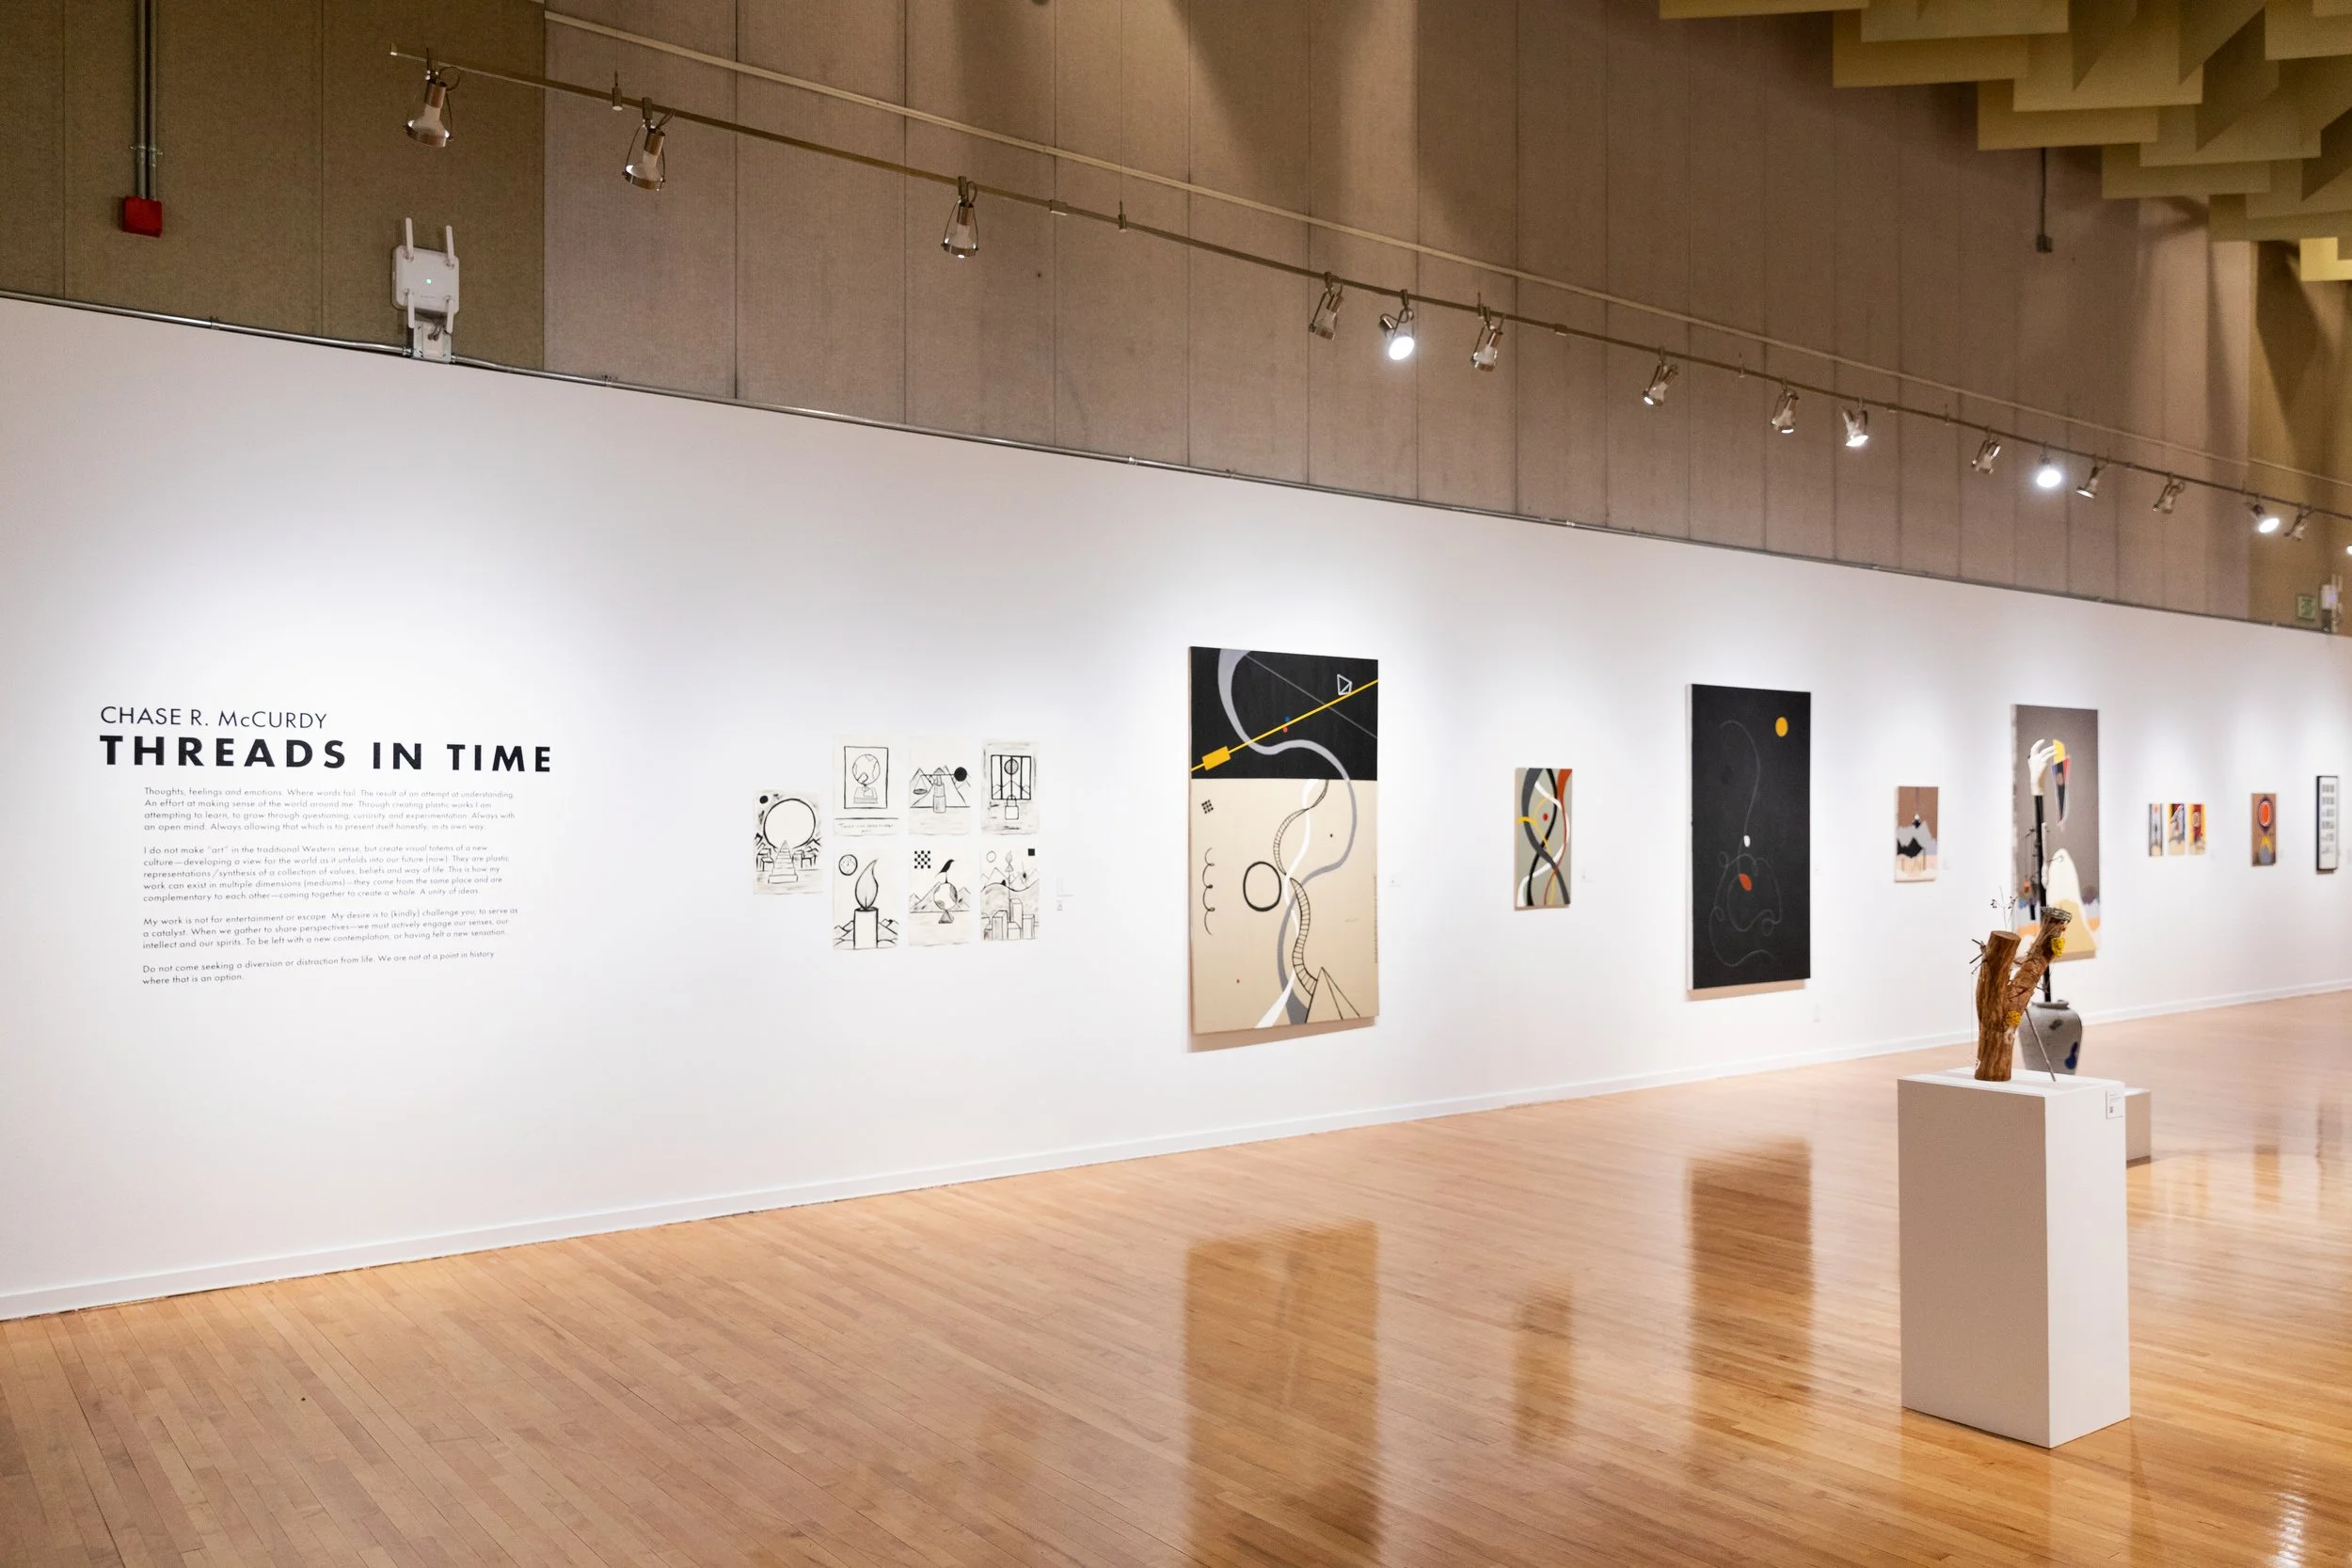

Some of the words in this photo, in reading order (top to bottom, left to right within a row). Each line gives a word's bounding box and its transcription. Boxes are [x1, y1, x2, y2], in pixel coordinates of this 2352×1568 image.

[101, 706, 181, 725] CHASE
[191, 709, 209, 725] R.
[218, 711, 327, 728] McCURDY
[100, 736, 345, 769] THREADS
[373, 742, 422, 770] IN
[447, 744, 550, 771] TIME
[188, 786, 223, 798] feelings
[224, 787, 242, 796] and
[144, 799, 158, 807] An
[159, 799, 184, 807] effort
[198, 800, 230, 809] making
[257, 799, 267, 807] of
[309, 800, 340, 808] around
[143, 811, 192, 821] attempting
[242, 813, 266, 821] grow
[266, 811, 300, 821] through
[157, 824, 182, 832] open
[210, 821, 242, 832] Always
[243, 822, 280, 832] allowing
[149, 846, 162, 854] do
[180, 846, 204, 854] make
[256, 845, 300, 853] traditional
[263, 856, 277, 864] for
[294, 856, 318, 864] world
[257, 868, 267, 877] of
[277, 867, 317, 876] collection
[318, 866, 327, 875] of
[358, 866, 385, 875] beliefs
[404, 868, 421, 877] way
[142, 881, 167, 890] work
[217, 879, 253, 890] multiple
[395, 877, 414, 885] from
[451, 877, 472, 886] place
[473, 875, 488, 883] and
[143, 893, 213, 903] complementary
[224, 891, 246, 900] each
[311, 890, 345, 899] together
[143, 918, 159, 927] My
[160, 916, 183, 925] work
[209, 914, 223, 924] for
[224, 914, 284, 923] entertainment
[330, 912, 344, 921] My
[390, 909, 421, 920] (kindly)
[421, 908, 459, 918] challenge
[189, 927, 217, 935] When
[233, 926, 262, 937] gather
[273, 925, 297, 933] share
[390, 920, 421, 931] actively
[421, 921, 452, 930] engage
[142, 941, 178, 949] intellect
[179, 939, 197, 948] and
[245, 937, 256, 945] To
[271, 936, 285, 944] left
[286, 935, 305, 943] with
[403, 931, 431, 941] having
[431, 929, 444, 938] felt
[158, 964, 173, 973] not
[200, 961, 234, 972] seeking
[243, 959, 283, 968] diversion
[295, 958, 339, 966] distraction
[340, 956, 359, 964] from
[438, 952, 459, 961] point
[469, 950, 495, 959] history
[142, 976, 170, 985] where
[172, 974, 190, 983] that
[191, 974, 199, 983] is
